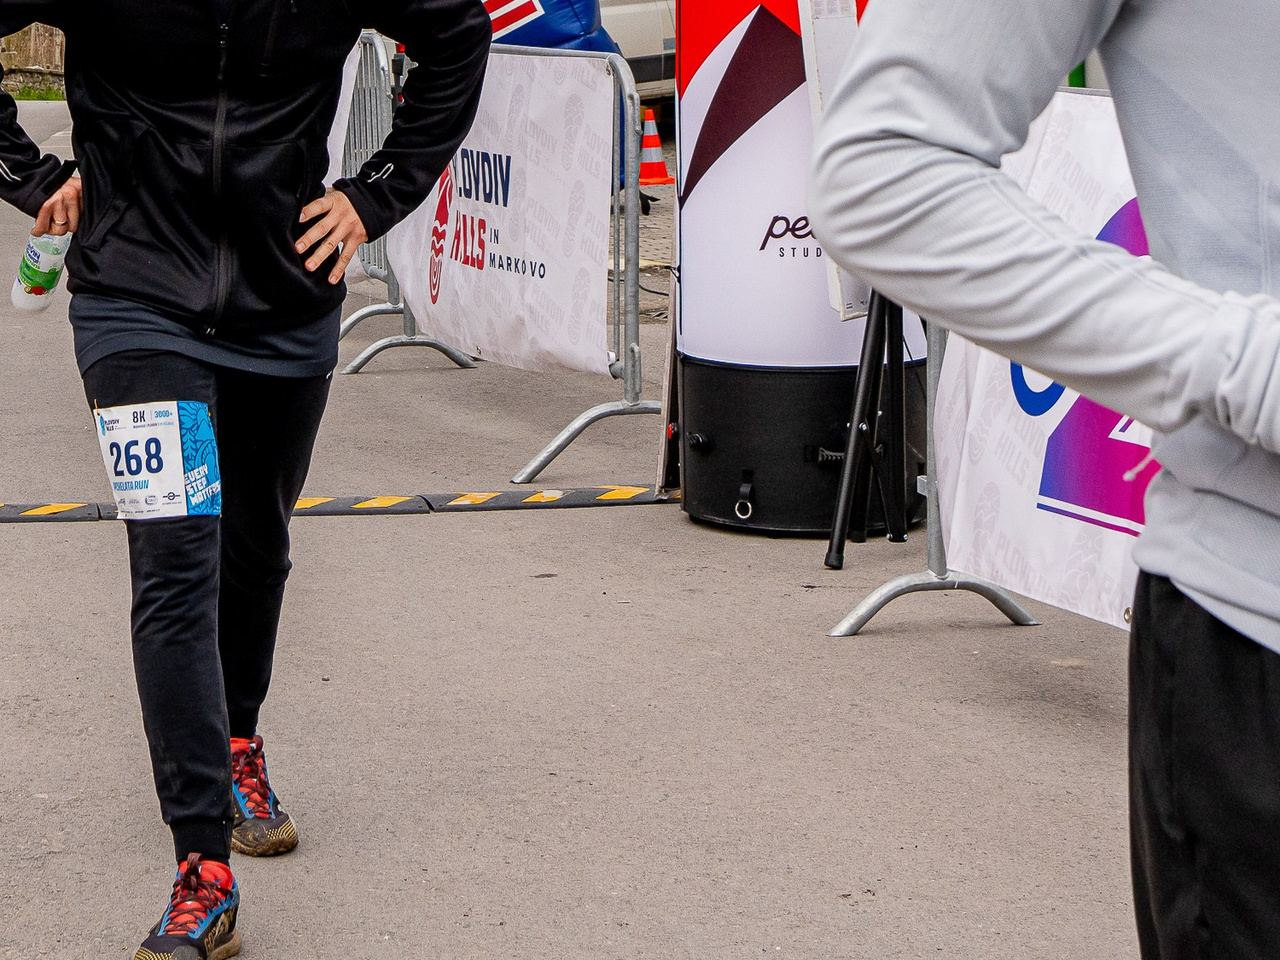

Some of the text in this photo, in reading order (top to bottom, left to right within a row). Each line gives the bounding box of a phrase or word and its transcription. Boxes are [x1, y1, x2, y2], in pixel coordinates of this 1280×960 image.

[453, 147, 511, 208] OVDIV
[489, 227, 499, 244] IN
[758, 214, 817, 252] pe
[489, 252, 546, 279] MARKOVO
[132, 409, 146, 424] 8K
[109, 437, 164, 477] 268
[134, 479, 150, 490] RUN
